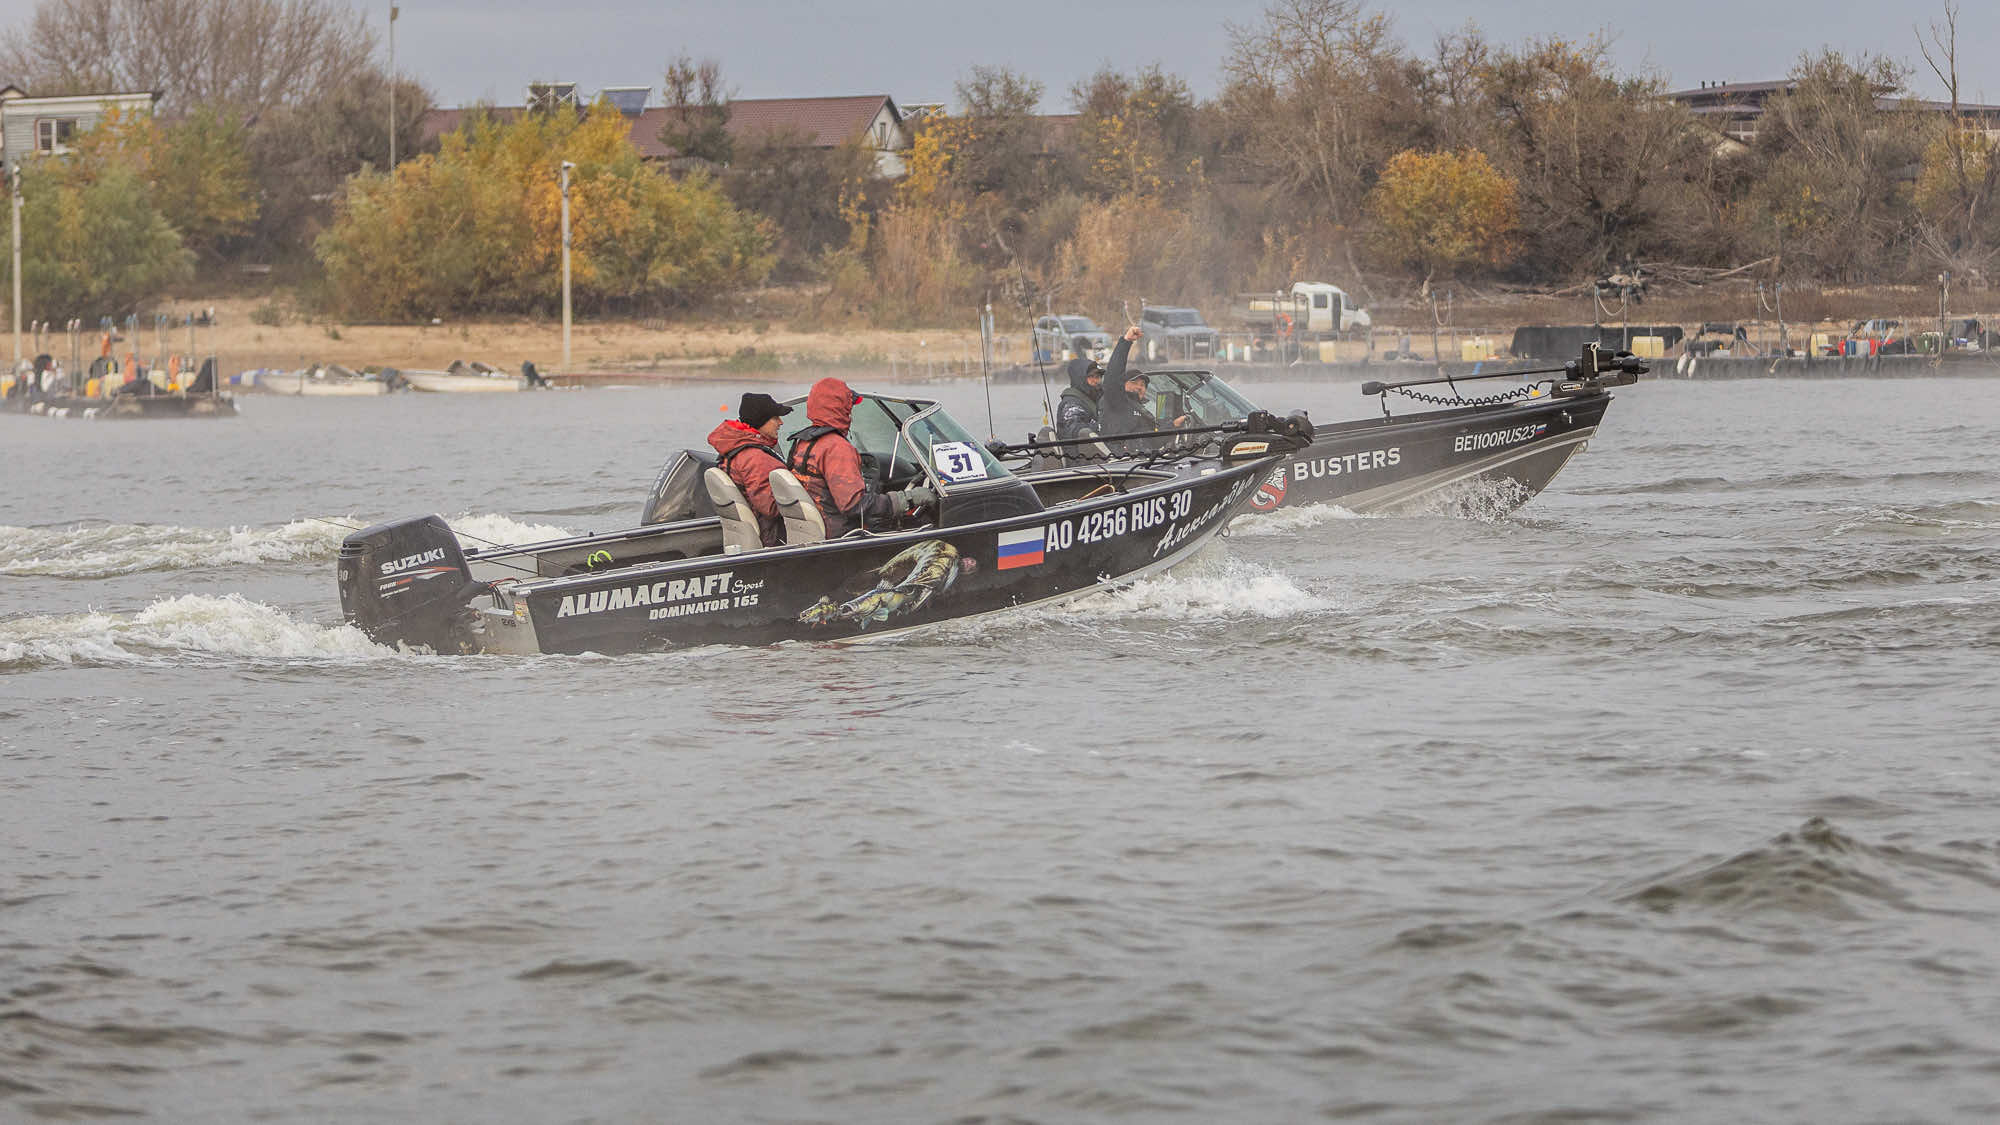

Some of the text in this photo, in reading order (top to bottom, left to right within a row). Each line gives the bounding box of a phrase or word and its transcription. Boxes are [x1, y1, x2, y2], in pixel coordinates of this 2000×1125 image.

[1454, 424, 1536, 452] BE1100RUS23
[948, 453, 973, 473] 31
[1293, 448, 1401, 481] BUSTERS
[1077, 506, 1127, 544] 4256
[1131, 496, 1166, 532] RUS
[1169, 489, 1192, 520] 30
[380, 547, 446, 575] SUZUKI
[557, 572, 733, 618] ALUMACRAFT
[732, 579, 764, 595] Sport
[649, 594, 759, 620] DOMINATOR 165
